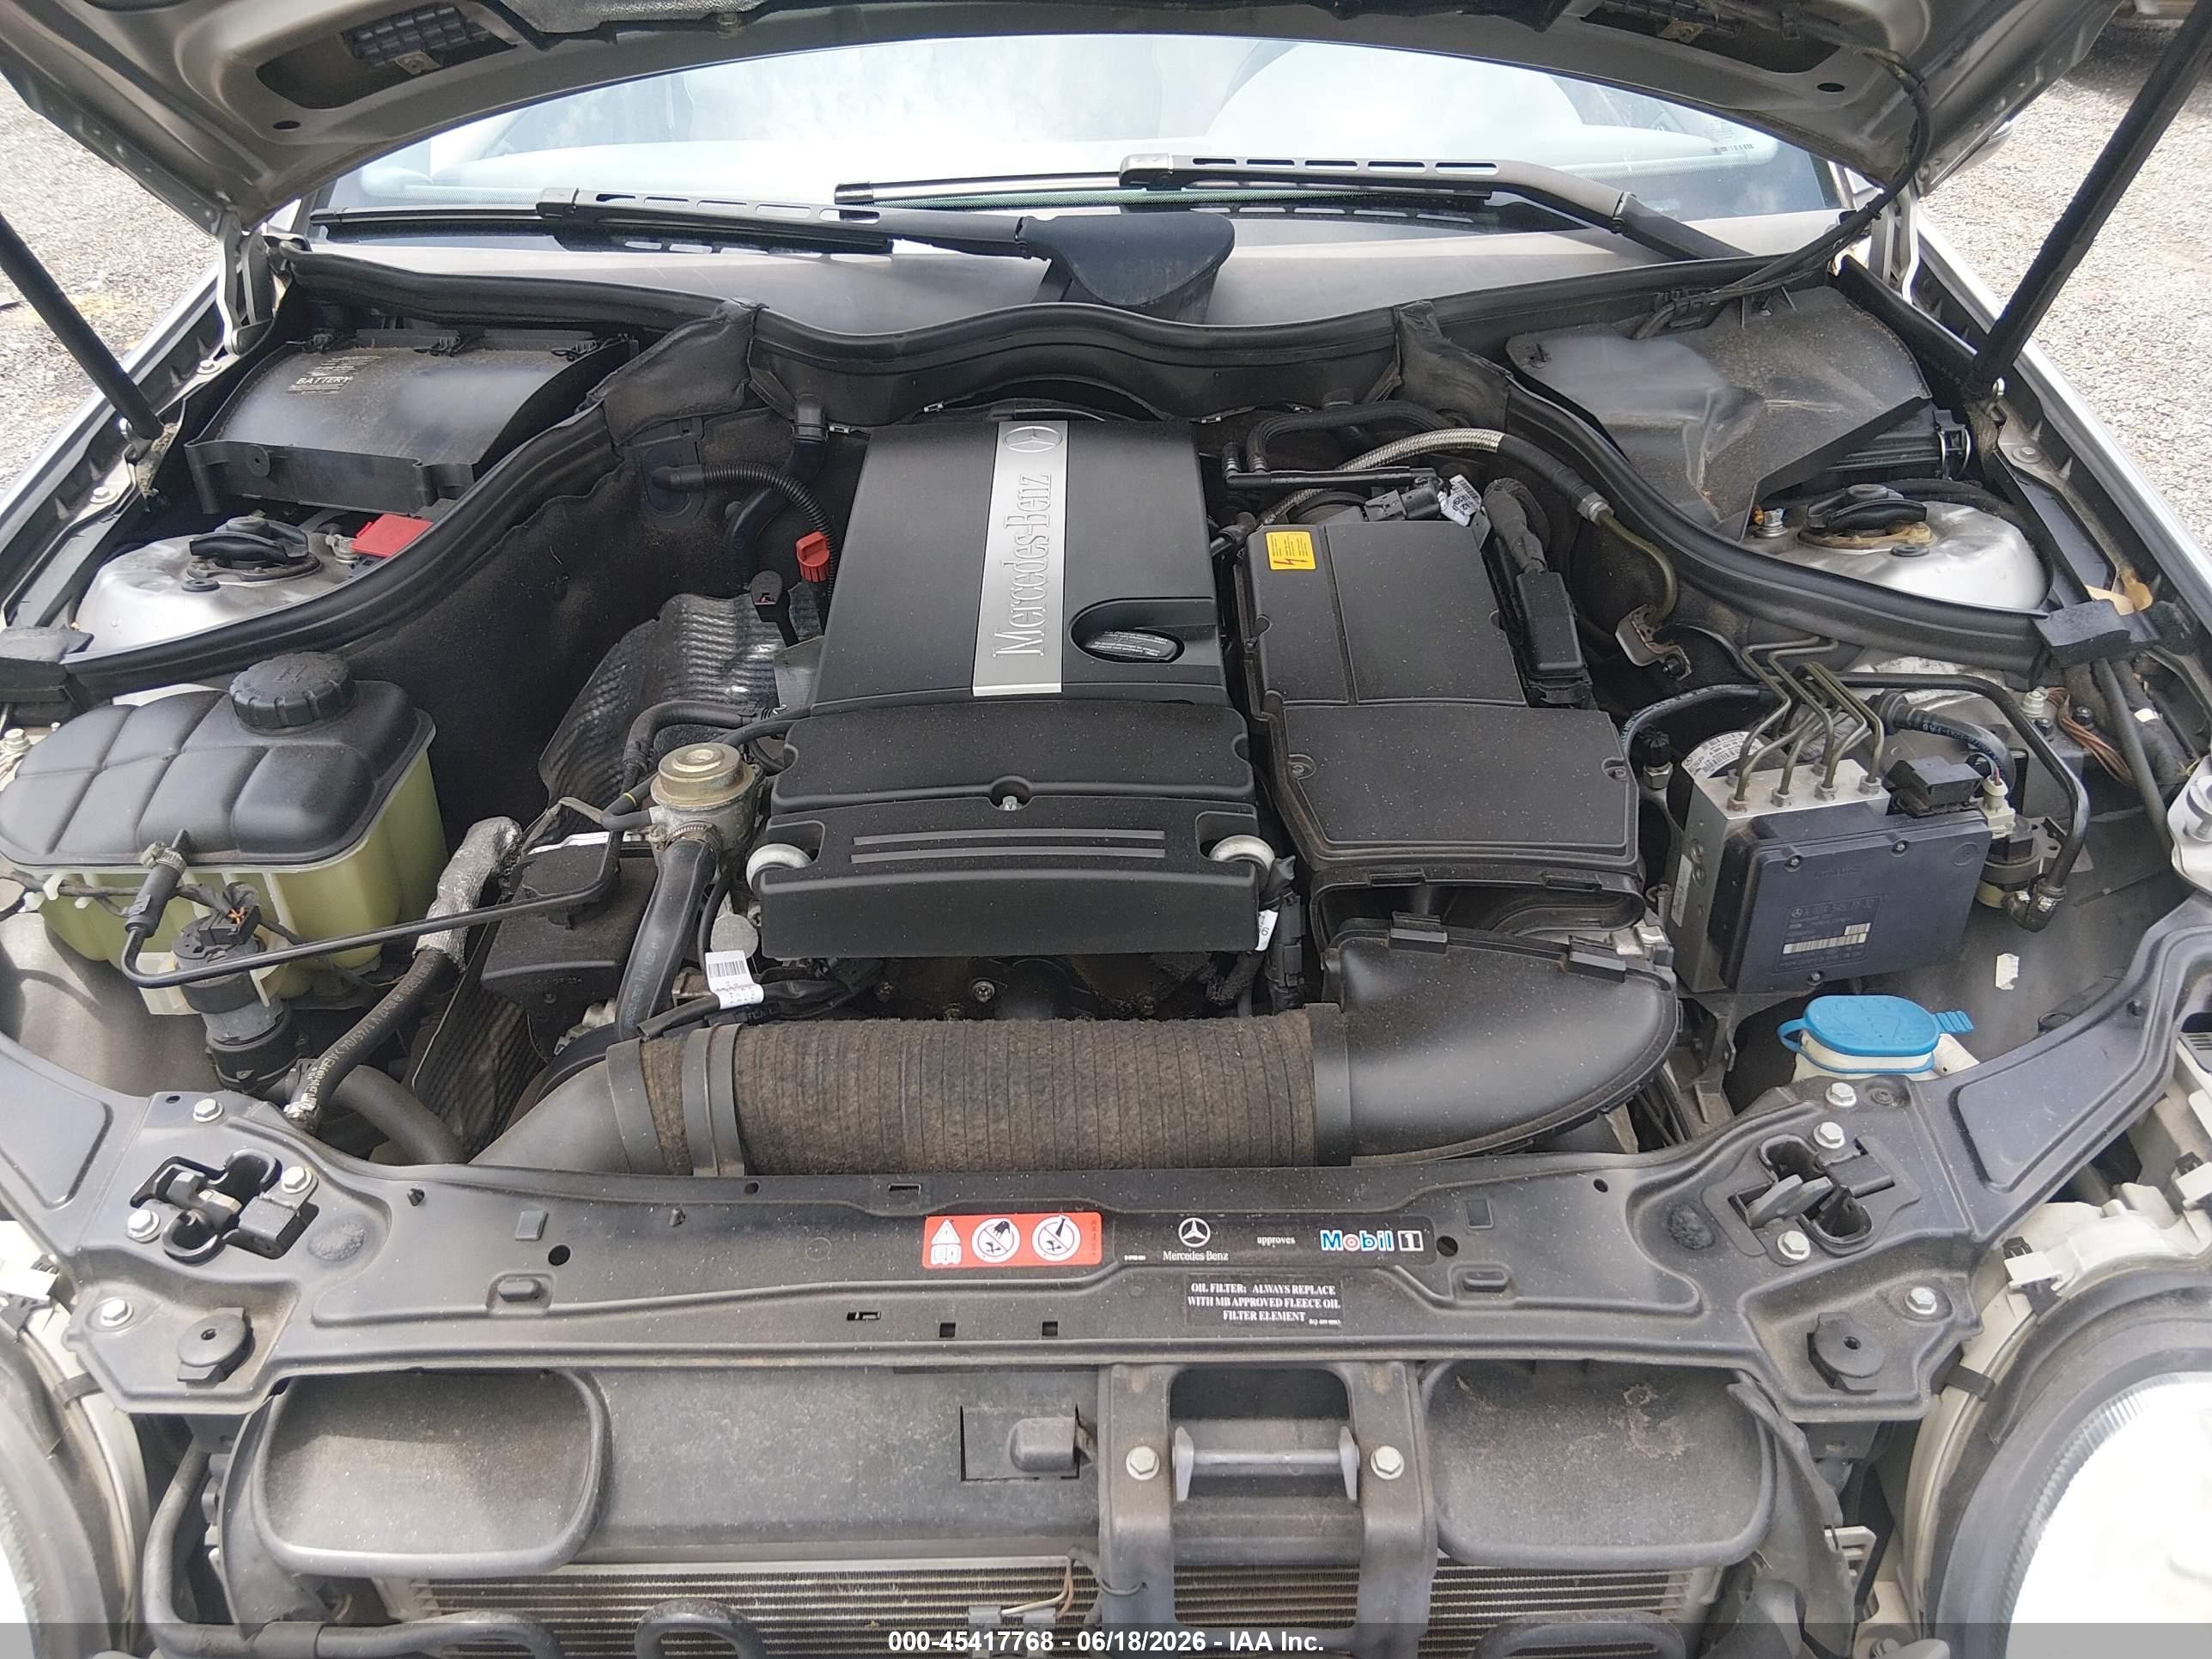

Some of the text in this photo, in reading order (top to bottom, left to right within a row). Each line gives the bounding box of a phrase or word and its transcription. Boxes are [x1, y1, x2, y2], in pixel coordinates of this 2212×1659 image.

[295, 376, 354, 385] BATTERY
[993, 473, 1052, 658] Mercedes-Benz
[1257, 1236, 1295, 1246] approves
[1320, 1230, 1395, 1251] Mobil
[1190, 1283, 1336, 1296] OIL FILTER: ALWAYS REPLACE
[1188, 1296, 1214, 1307] WITH
[1215, 1297, 1231, 1307] MB
[1231, 1297, 1284, 1308] APPROVED
[1285, 1297, 1322, 1309] FLEECE
[1223, 1310, 1306, 1322] FILTER ELEMENT
